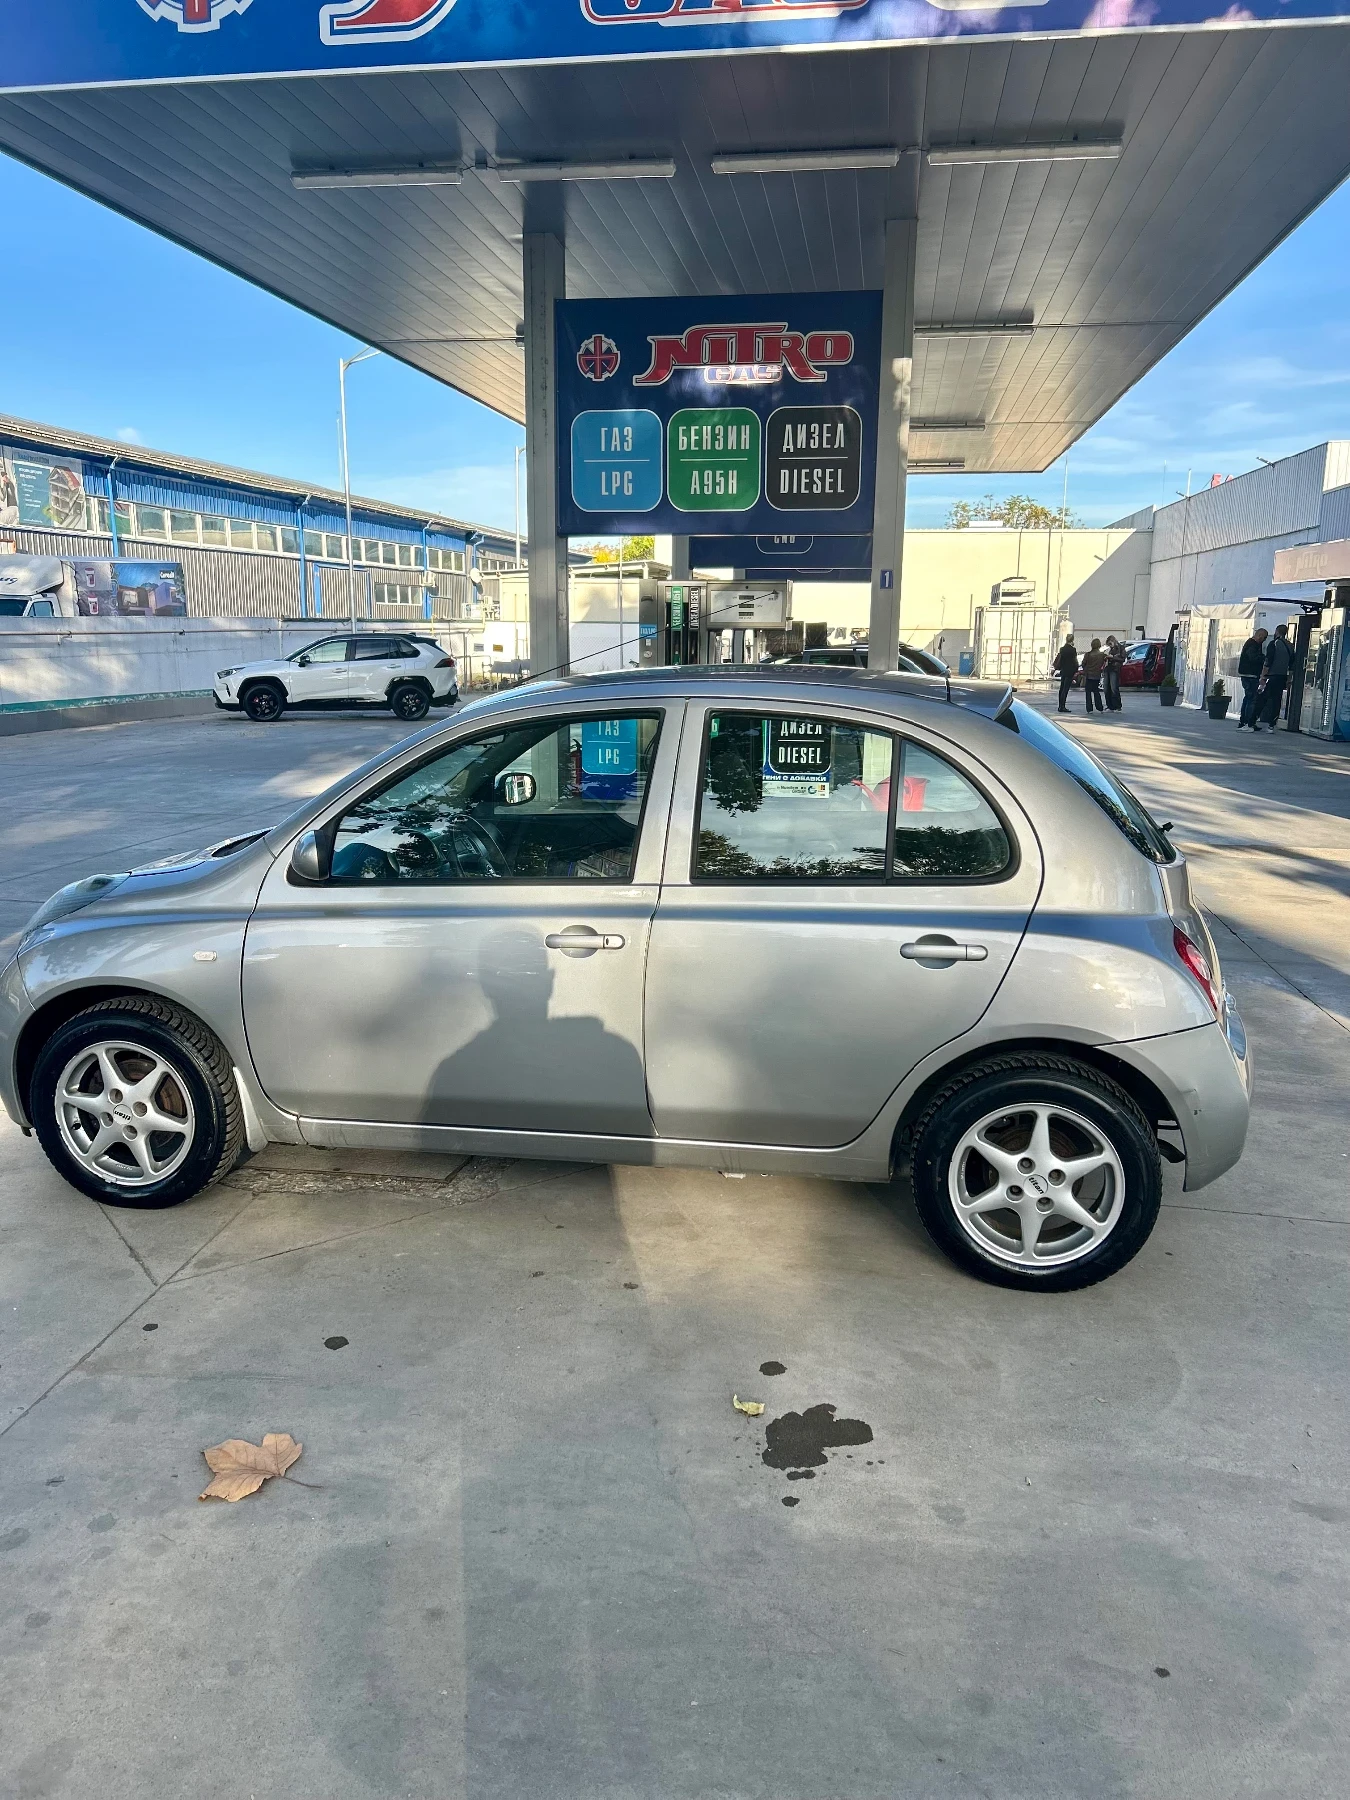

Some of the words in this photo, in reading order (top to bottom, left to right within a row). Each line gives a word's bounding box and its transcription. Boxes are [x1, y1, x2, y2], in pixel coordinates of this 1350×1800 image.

[633, 322, 854, 386] NITRO
[704, 365, 783, 385] GAS
[601, 426, 633, 452] ГАЗ
[678, 425, 750, 451] БЕНЗИН
[782, 423, 845, 453] ДИЗЕЛ
[601, 470, 633, 496] LPG
[690, 470, 738, 495] A95H
[779, 468, 845, 494] DIESEL
[884, 571, 890, 588] 1
[598, 748, 620, 765] LPG
[778, 746, 822, 764] DIESEL
[1029, 1177, 1044, 1194] titan
